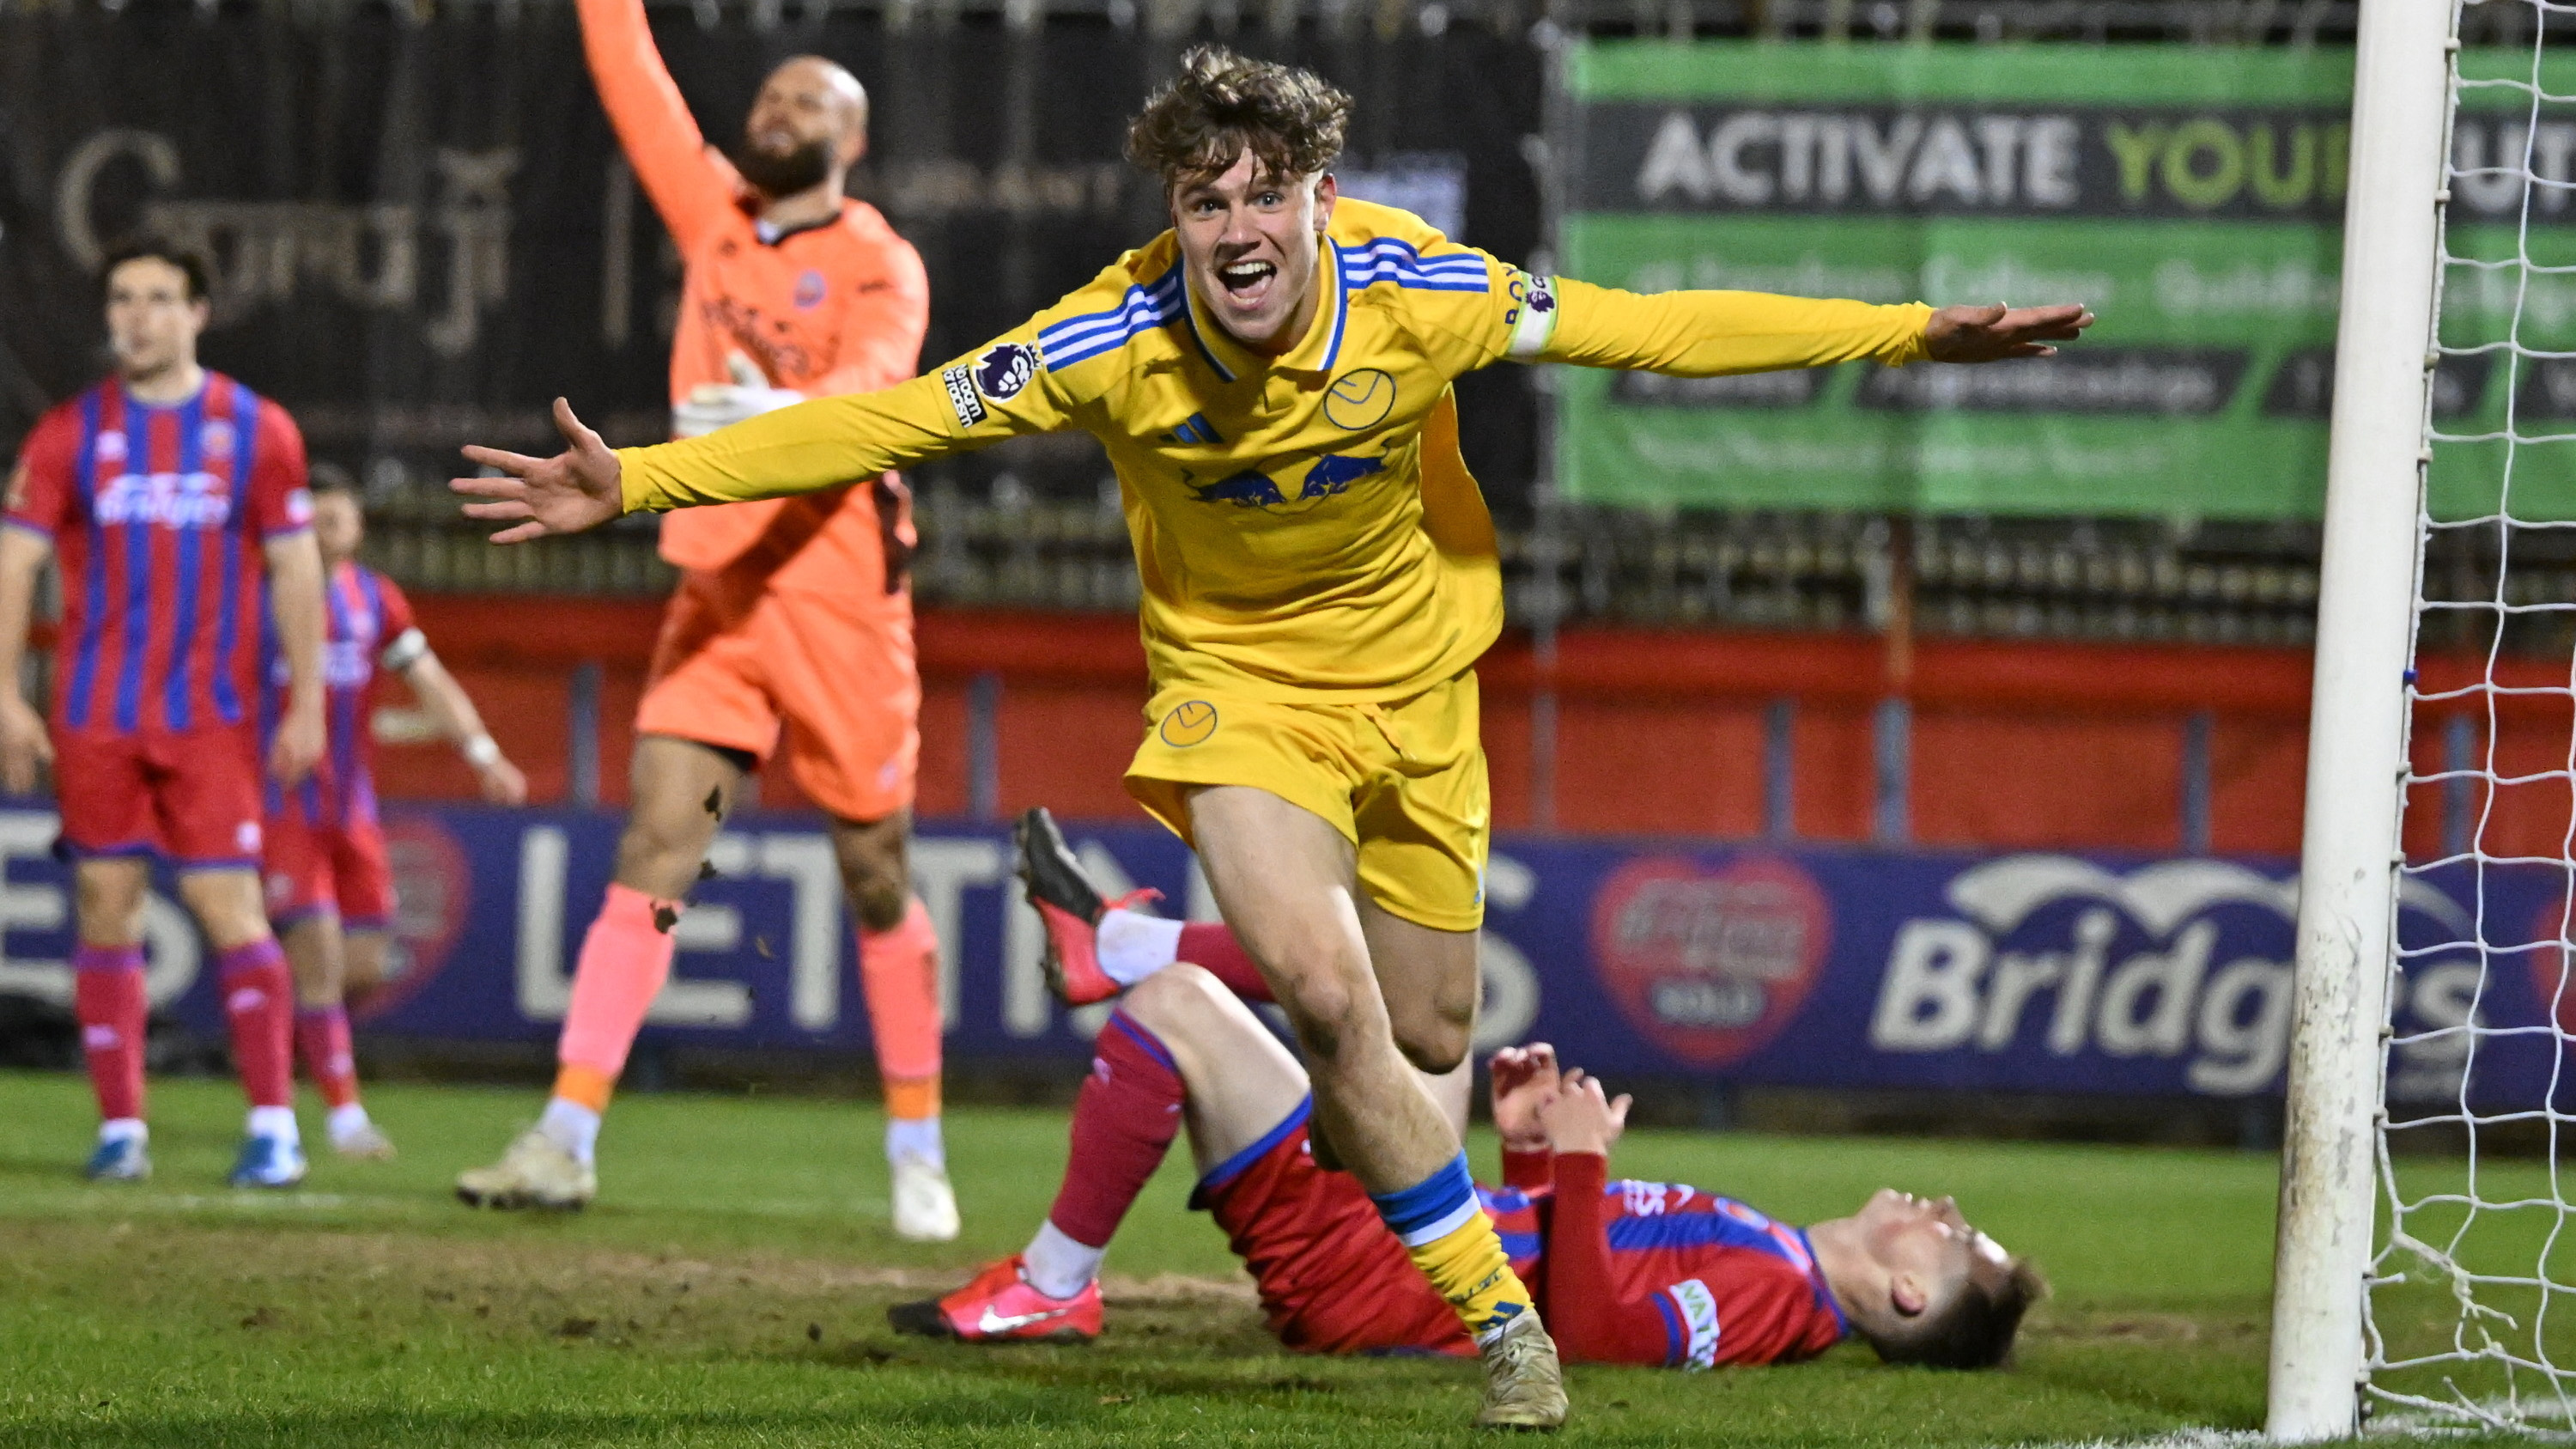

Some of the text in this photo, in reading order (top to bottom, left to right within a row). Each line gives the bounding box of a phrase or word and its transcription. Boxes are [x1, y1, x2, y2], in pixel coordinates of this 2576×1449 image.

[1637, 112, 2081, 207] ACTIVATE
[2453, 120, 2576, 215] UT
[946, 381, 973, 429] racism
[957, 377, 982, 418] room
[1868, 908, 2492, 1097] Bridgs
